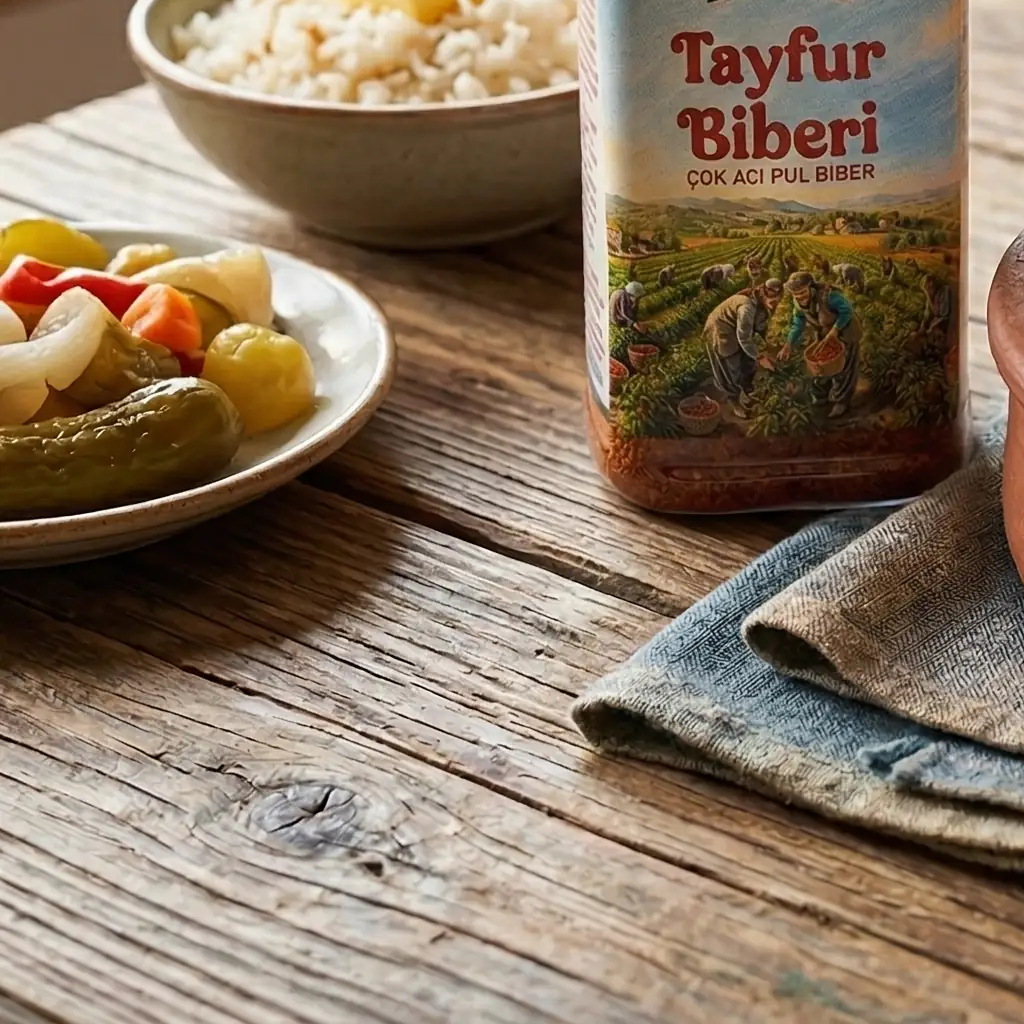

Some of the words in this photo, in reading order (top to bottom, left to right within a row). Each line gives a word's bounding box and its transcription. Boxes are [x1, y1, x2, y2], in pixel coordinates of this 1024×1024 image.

[670, 26, 886, 99] Tayfur
[677, 100, 879, 161] Biberi
[687, 169, 727, 190] ÇOK
[732, 168, 764, 185] ACI
[771, 167, 810, 184] PUL
